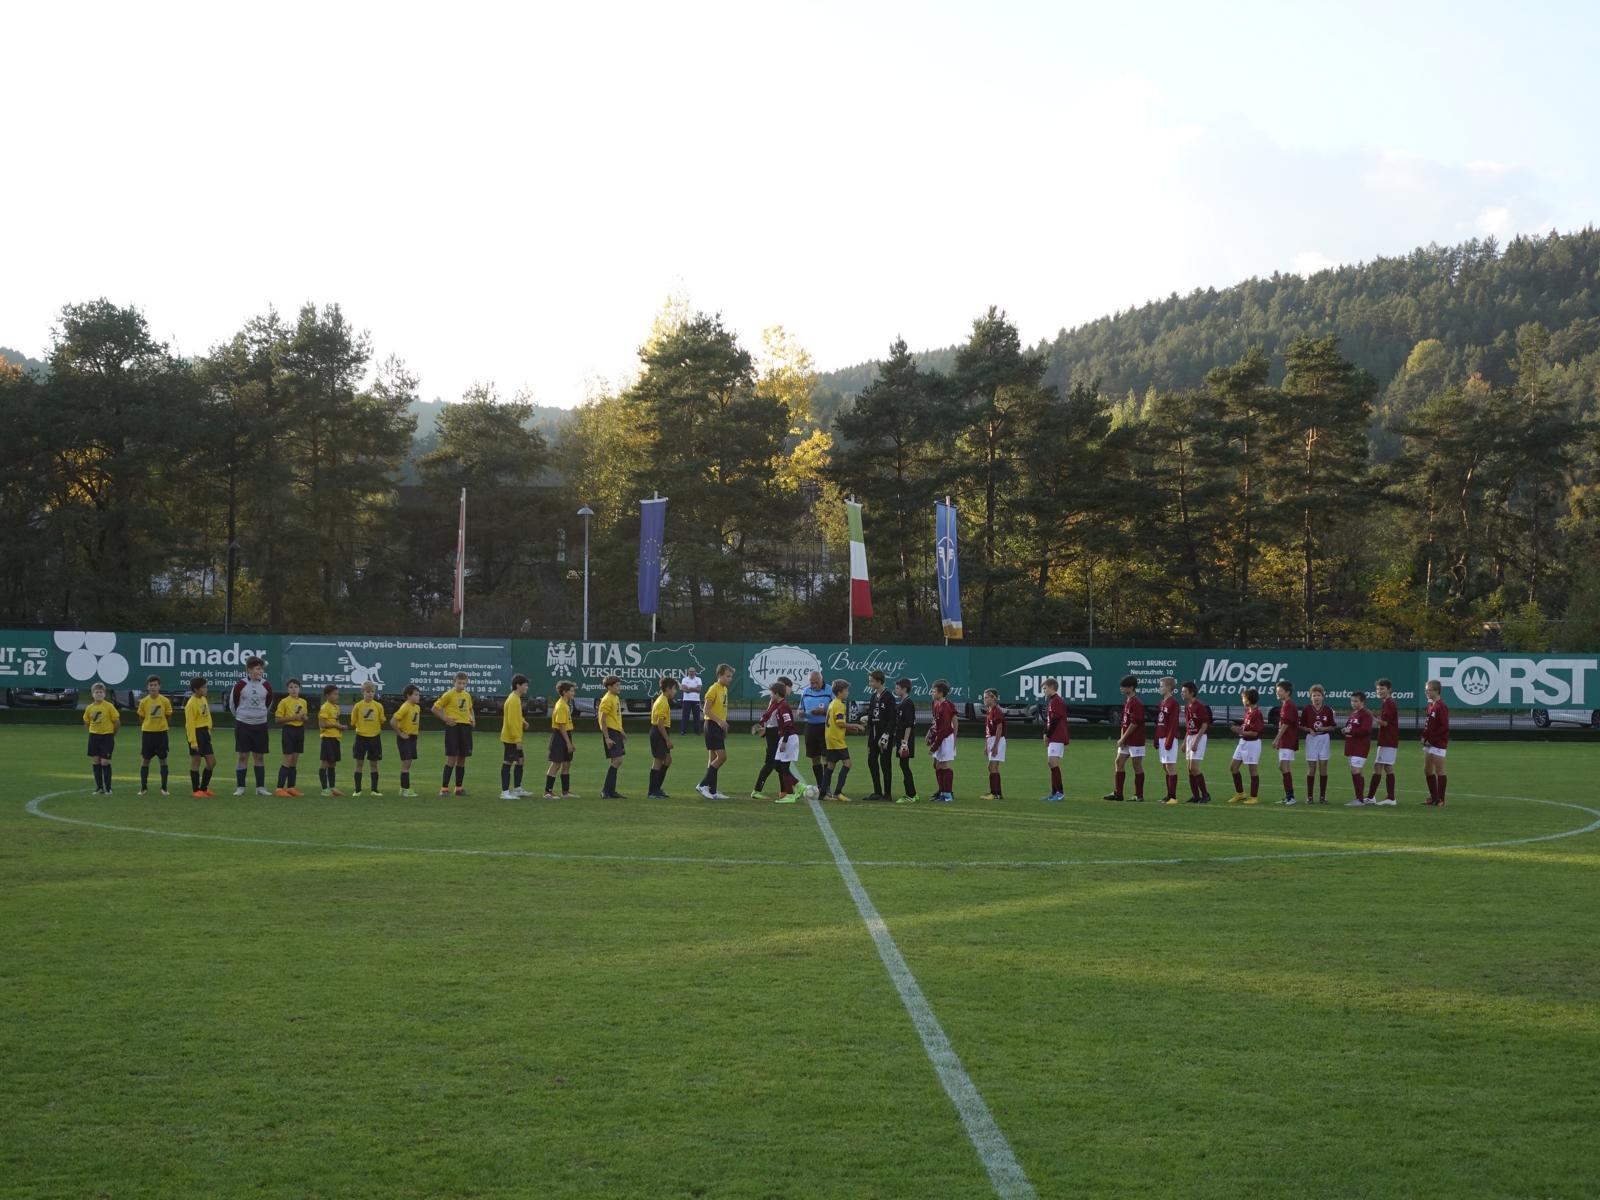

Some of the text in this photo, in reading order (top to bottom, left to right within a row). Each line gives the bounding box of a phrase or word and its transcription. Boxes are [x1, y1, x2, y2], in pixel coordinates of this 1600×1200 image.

[337, 641, 457, 650] www.physio-bruneck.com
[581, 643, 642, 667] ITAS
[23, 660, 47, 676] BZ
[828, 649, 907, 678] Backkunst
[203, 670, 213, 678] als
[581, 667, 688, 679] VERSICHERUNGEN
[1428, 656, 1598, 706] FORST
